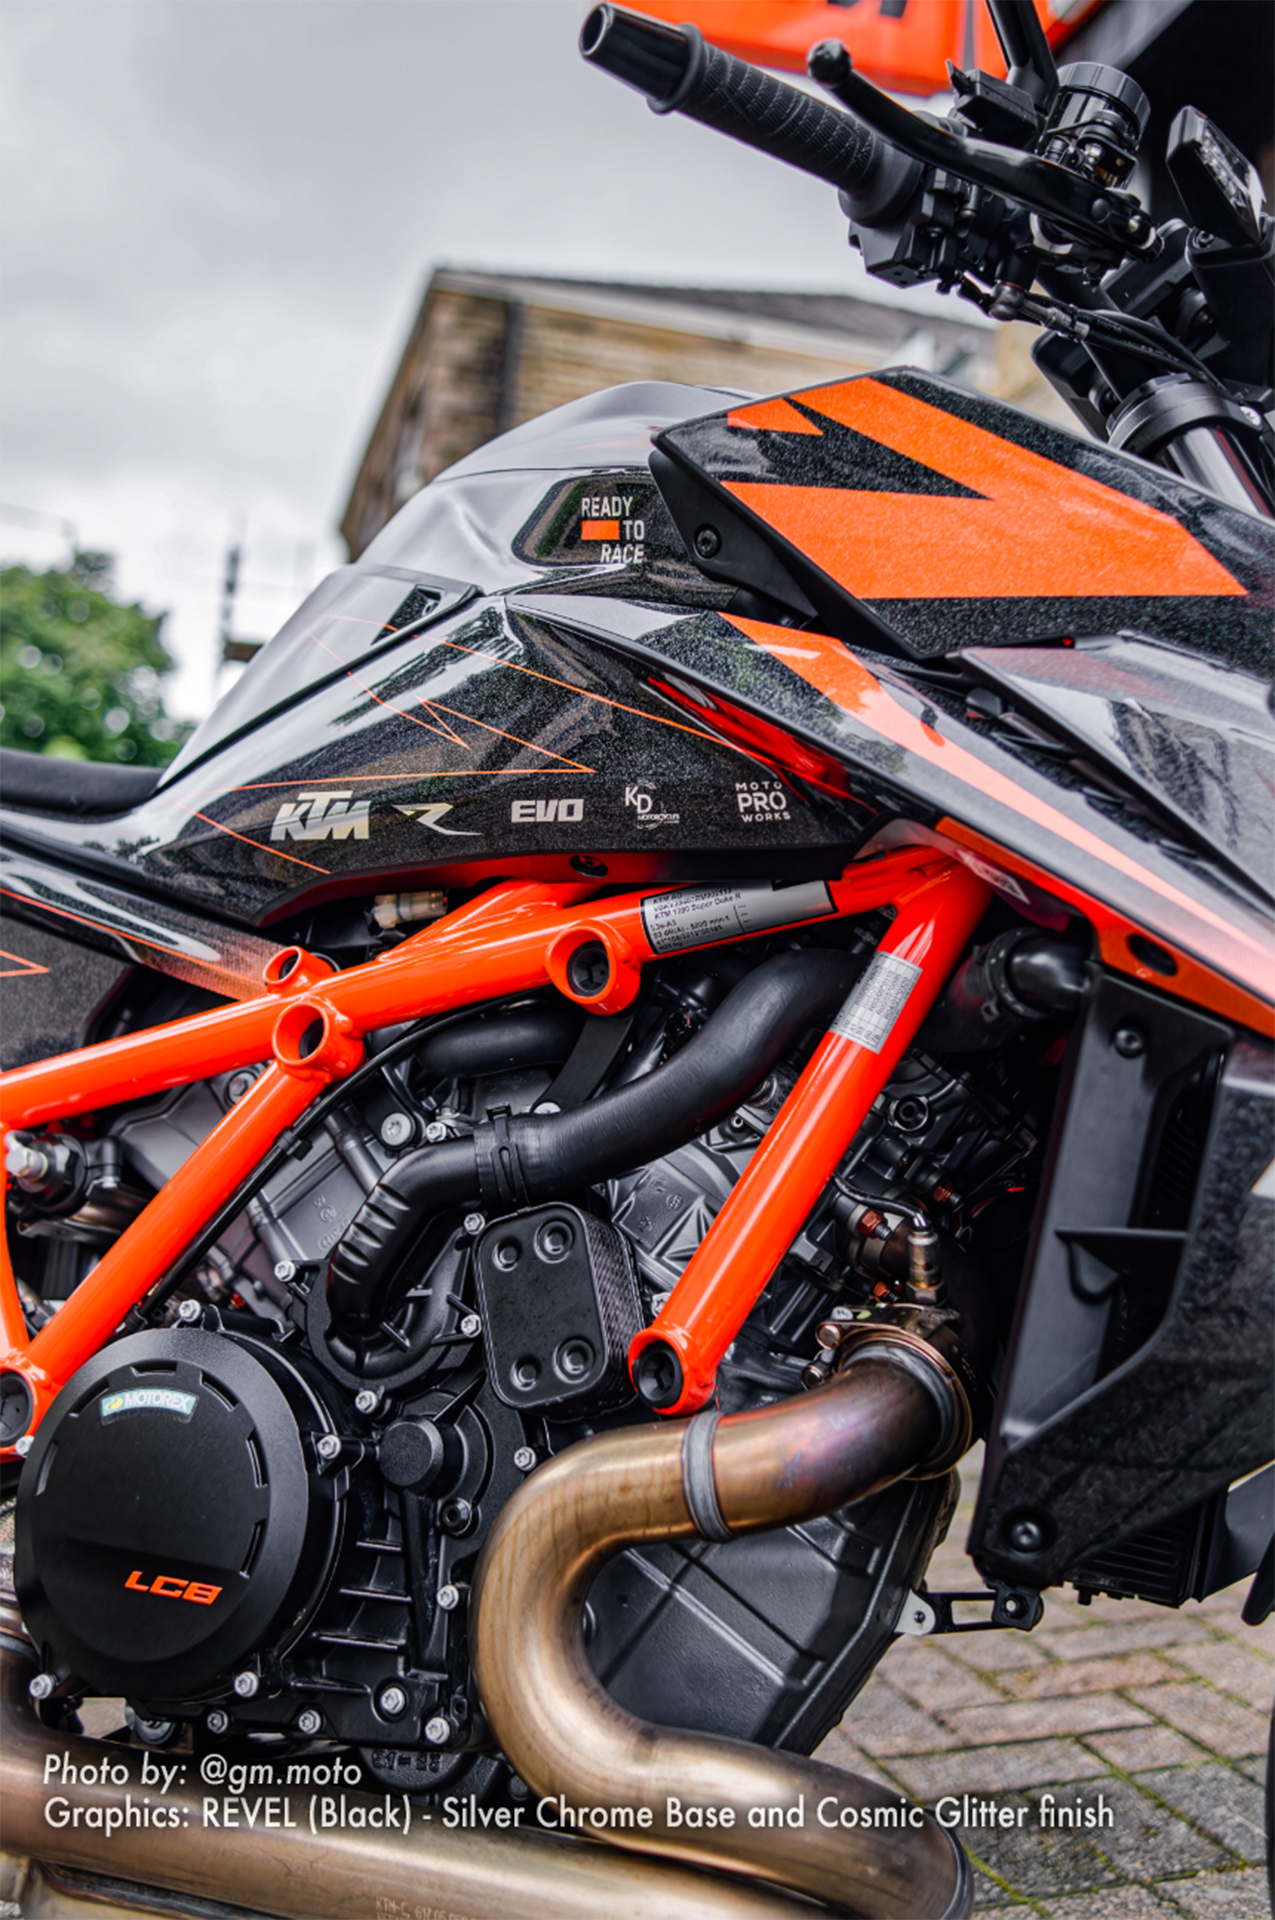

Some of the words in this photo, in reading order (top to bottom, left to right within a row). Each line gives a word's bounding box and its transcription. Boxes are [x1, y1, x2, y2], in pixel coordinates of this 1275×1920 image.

[581, 496, 633, 517] READY
[622, 520, 645, 540] TO
[600, 543, 645, 564] RACE
[735, 781, 782, 791] MOTO
[511, 798, 584, 822] EVO
[737, 791, 787, 813] PRO
[270, 790, 372, 841] KTM
[741, 811, 791, 823] WORKS
[124, 1390, 192, 1412] MOTOREX
